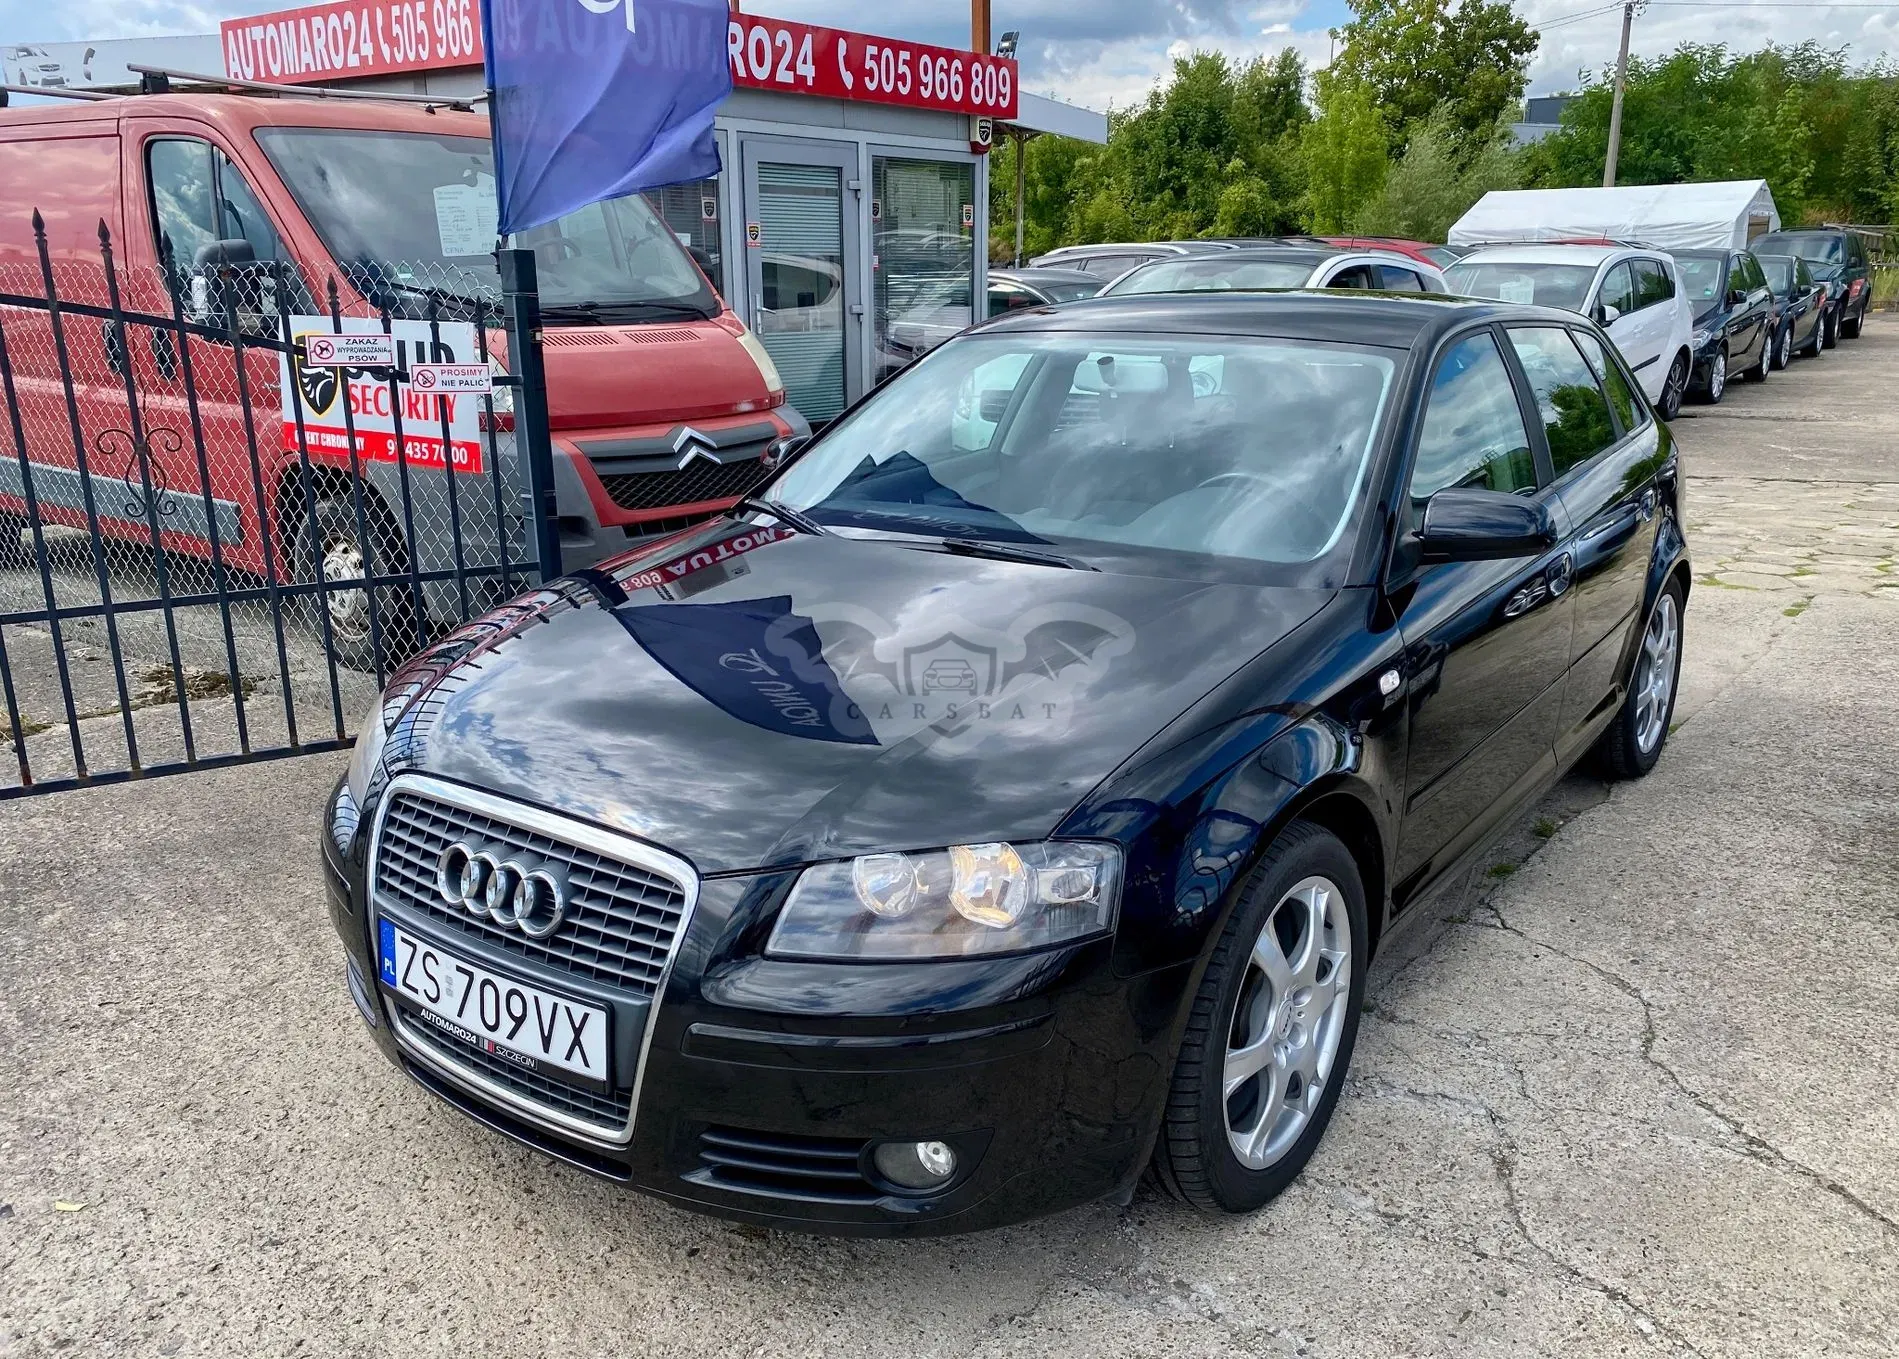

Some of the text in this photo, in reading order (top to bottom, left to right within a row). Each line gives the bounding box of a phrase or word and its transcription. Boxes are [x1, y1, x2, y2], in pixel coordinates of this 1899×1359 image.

[228, 8, 374, 80] AUTOMARO24
[392, 1, 429, 63] 505
[433, 0, 473, 58] 966
[865, 45, 911, 95] 505
[920, 54, 963, 102] 966
[971, 62, 1010, 108] 809
[337, 346, 387, 354] WYPROWADZANIA
[348, 354, 378, 362] PSÓW
[440, 368, 482, 376] PROSIMY
[441, 377, 484, 387] NIE PALIĆ
[405, 441, 429, 460] 435
[384, 957, 395, 976] PL
[400, 936, 591, 1069] ZS 709VX
[420, 1008, 536, 1069] AUTOMARO24 SZCZECIN
